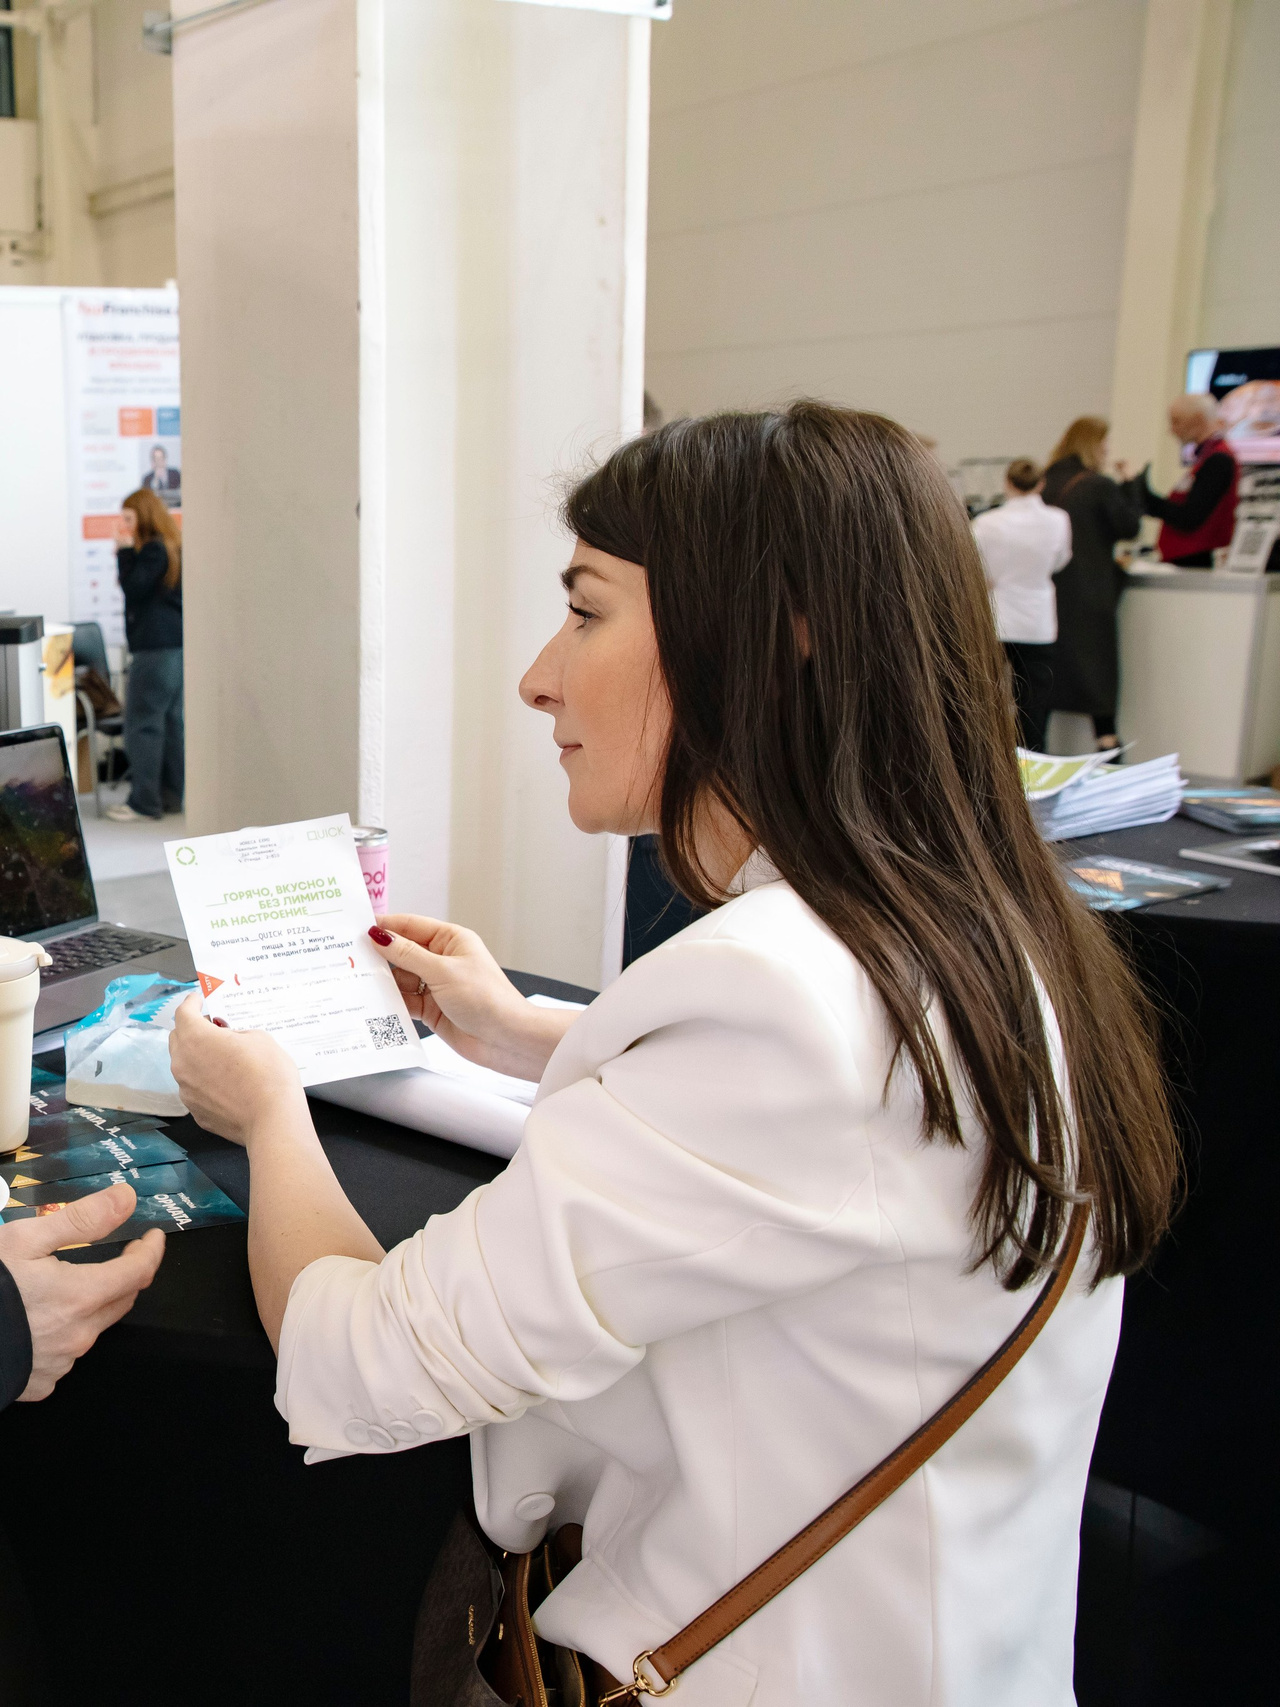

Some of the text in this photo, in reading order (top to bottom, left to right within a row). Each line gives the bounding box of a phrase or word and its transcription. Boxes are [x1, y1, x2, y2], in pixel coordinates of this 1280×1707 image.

[275, 878, 324, 894] ВКУСНО
[327, 876, 336, 885] И
[258, 888, 341, 909] БЕЗ ЛИМИТОВ
[210, 918, 228, 928] НА
[246, 940, 352, 962] через вендинговый аппарат
[261, 942, 283, 950] пицца
[308, 935, 334, 943] минуты
